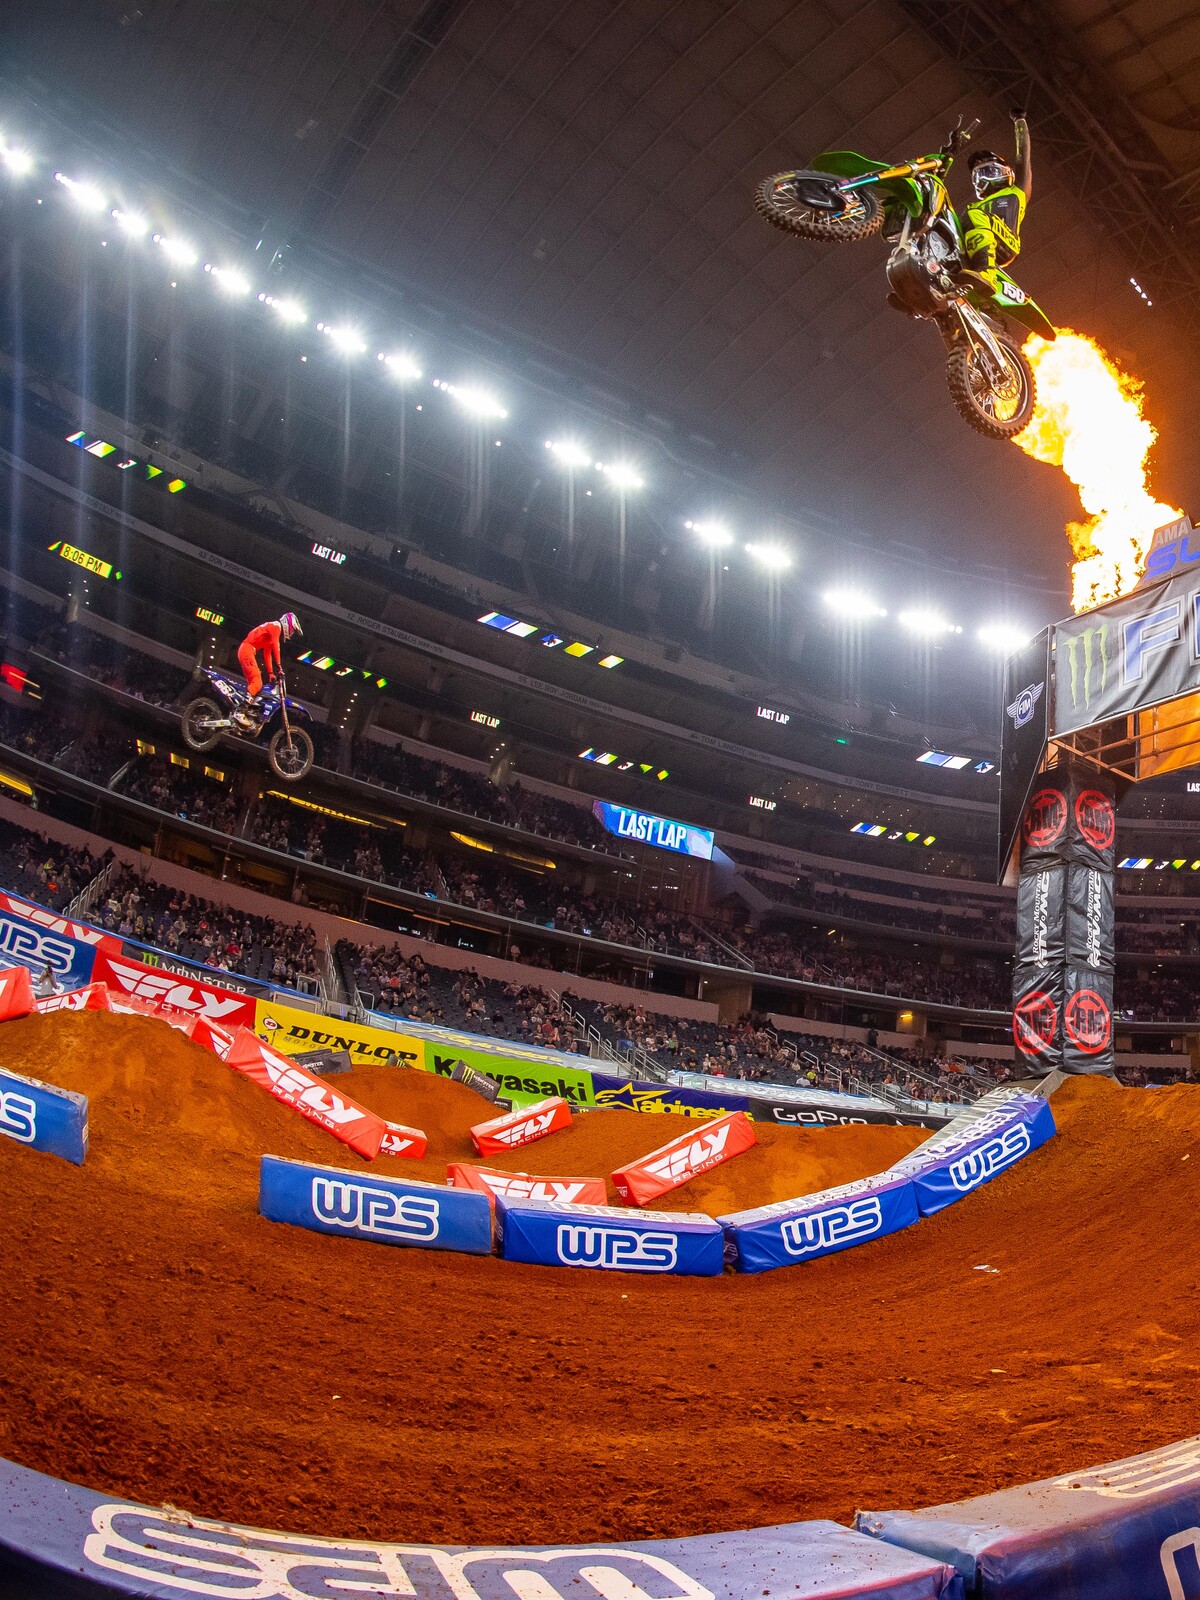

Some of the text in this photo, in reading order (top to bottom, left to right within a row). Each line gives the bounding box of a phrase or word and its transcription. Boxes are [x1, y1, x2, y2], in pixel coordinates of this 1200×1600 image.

[1001, 281, 1025, 303] 150
[1154, 520, 1189, 547] AMA
[62, 543, 103, 574] 8:06 PM
[312, 542, 347, 566] LAST LAP
[196, 607, 225, 626] LAST LAP
[470, 710, 501, 729] LAST LAP
[756, 706, 790, 724] LAST LAP
[749, 795, 776, 811] LAST LAP
[618, 810, 687, 849] LAST LAP
[1032, 872, 1042, 955] ROCKY MOUNTAIN
[1086, 868, 1095, 951] ROCKY MOUNTAIN
[106, 958, 247, 1018] FLY
[161, 962, 247, 995] MONSTER
[130, 993, 197, 1019] RACIN
[286, 1025, 418, 1061] DUNLOP
[259, 1046, 367, 1125] FLY
[434, 1055, 589, 1103] Kwasaki
[491, 1108, 557, 1144] FLY
[640, 1098, 755, 1122] alpinests
[773, 1107, 868, 1126] GoPro
[380, 1132, 415, 1152] LY
[642, 1123, 731, 1180] FLY
[949, 1122, 1030, 1191] WPS
[312, 1177, 440, 1241] WPS
[781, 1196, 882, 1256] WPS
[557, 1225, 678, 1271] WPS
